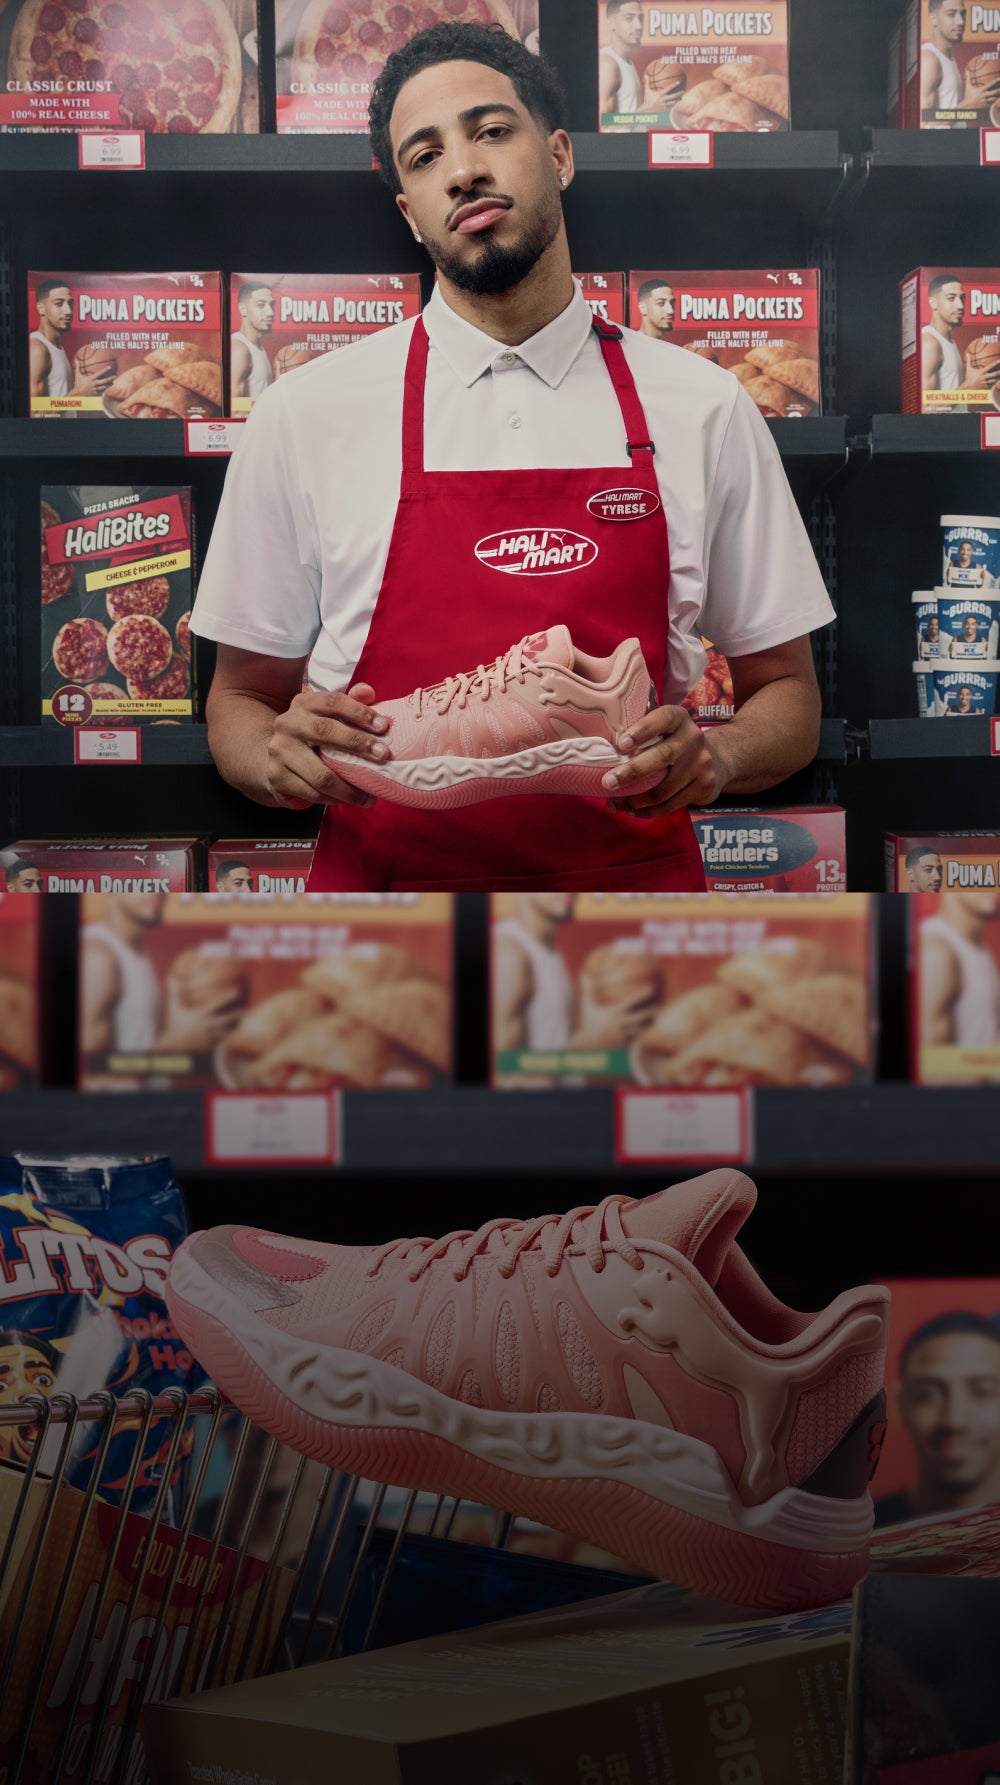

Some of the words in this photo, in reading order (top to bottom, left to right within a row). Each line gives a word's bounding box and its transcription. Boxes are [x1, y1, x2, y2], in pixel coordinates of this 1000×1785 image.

[649, 9, 698, 36] PUMA
[702, 9, 772, 36] POCKETS
[676, 47, 699, 55] FILLED
[700, 46, 718, 55] WITH
[720, 46, 737, 55] HEAT
[661, 56, 678, 64] JUST
[680, 56, 695, 64] LIKE
[720, 55, 736, 64] STAT
[737, 55, 752, 64] LINE
[6, 81, 64, 92] CLASSIC
[67, 81, 113, 92] CRUST
[290, 82, 348, 94] CLASSIC
[30, 99, 59, 108] MADE
[61, 99, 90, 108] WITH
[314, 100, 343, 109] MADE
[11, 110, 36, 119] 100%
[39, 110, 66, 119] REAL
[68, 110, 110, 119] CHEESE
[323, 112, 349, 121] REAL
[79, 295, 129, 321] PUMA
[133, 295, 205, 322] POCKETS
[280, 296, 330, 323] PUMA
[333, 297, 404, 324] POCKETS
[680, 294, 729, 320] PUMA
[733, 294, 803, 320] POCKETS
[106, 333, 130, 341] FILLED
[132, 333, 150, 341] WITH
[152, 333, 169, 341] HEAT
[307, 334, 330, 342] FILLED
[332, 334, 350, 342] WITH
[707, 331, 731, 340] FILLED
[732, 331, 751, 340] WITH
[752, 331, 769, 339] HEAT
[91, 341, 109, 350] JUST
[110, 341, 126, 350] LIKE
[128, 341, 150, 350] HALI'S
[151, 341, 168, 350] STAT
[169, 341, 185, 350] LINE
[293, 343, 310, 351] JUST
[311, 343, 326, 351] LIKE
[693, 340, 710, 348] JUST
[712, 340, 727, 348] LIKE
[728, 340, 750, 348] HALI'S
[751, 339, 767, 348] STAT
[769, 339, 784, 348] LINE
[208, 435, 227, 443] 6.99
[605, 493, 622, 502] HALI
[622, 493, 643, 501] MART
[84, 502, 108, 516] PIZZA
[108, 494, 140, 510] SNACKS
[602, 503, 647, 515] TYRESE
[65, 512, 170, 558] HaliBites
[498, 532, 549, 556] HALI
[522, 543, 589, 570] MART
[106, 569, 132, 582] CHEESE
[139, 559, 177, 573] PEPPERONI
[58, 694, 85, 712] 12
[701, 825, 774, 847] Tyrese
[699, 843, 779, 863] Tenders
[947, 861, 996, 887] PUMA
[48, 875, 95, 893] PUMA
[100, 875, 170, 893] POCKETS
[258, 874, 306, 893] PUMA
[714, 882, 736, 891] CRISPY,
[737, 882, 759, 890] CLUTCH
[816, 883, 845, 892] PROTEIN
